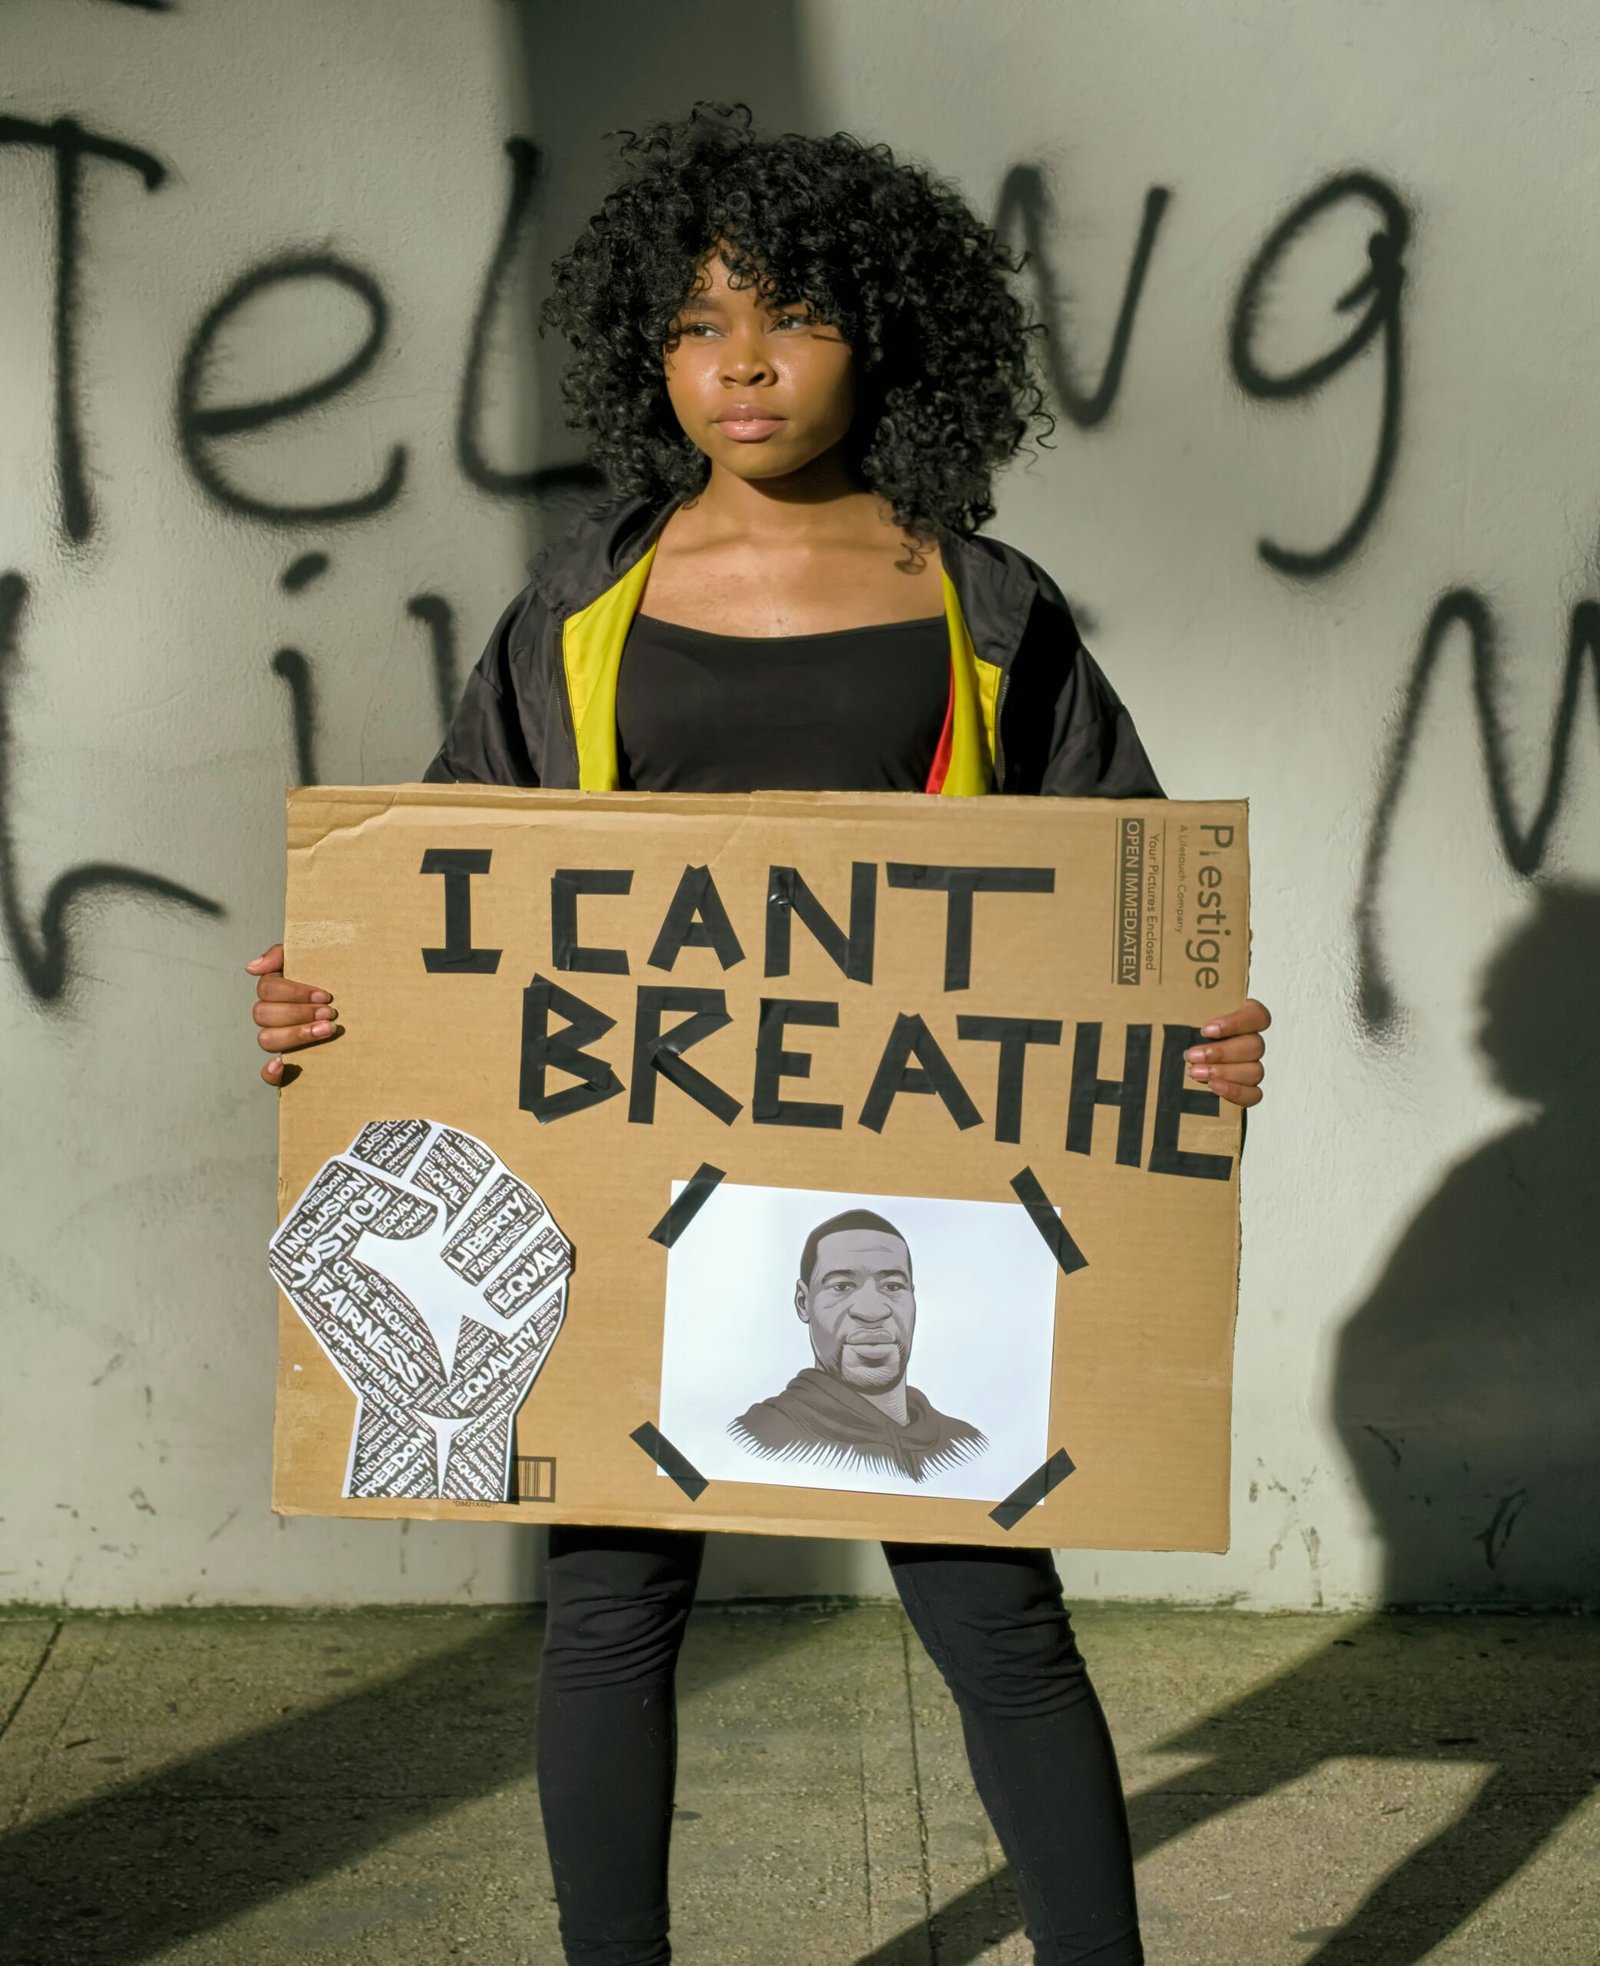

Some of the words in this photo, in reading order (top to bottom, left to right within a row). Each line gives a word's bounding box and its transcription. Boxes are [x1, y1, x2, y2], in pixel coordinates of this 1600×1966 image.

[1126, 821, 1139, 868] OPEN
[1148, 834, 1160, 862] Your
[1180, 824, 1189, 832] A
[1177, 835, 1189, 882] Lifetouch
[1147, 864, 1159, 912] Pictures
[1174, 884, 1187, 934] Company
[420, 848, 504, 974] I
[551, 861, 1055, 992] CANT
[1122, 872, 1138, 983] IMMEDIATELY
[1145, 916, 1158, 971] Enclosed
[519, 973, 1233, 1181] BREATHE
[361, 1120, 400, 1155] JUSTIC
[372, 1120, 423, 1166] EQUALITY
[455, 1137, 490, 1169] LIBERTY
[435, 1137, 483, 1183] FREEDOM
[448, 1166, 474, 1193] RIGHTS
[301, 1170, 347, 1214] FREEDOM
[421, 1161, 463, 1205] EQUAL
[470, 1179, 518, 1223] INCLUSION
[280, 1172, 368, 1255] INCLUSION
[375, 1199, 414, 1234] EQUAL
[395, 1205, 431, 1235] EQUAL
[446, 1191, 528, 1271] LIBERTY
[290, 1184, 392, 1288] JUSTICE
[448, 1224, 475, 1248] EQUALITY
[470, 1221, 528, 1276] FAIRNESS
[522, 1229, 550, 1256] EQUALITY
[368, 1274, 389, 1297] CIVIL
[388, 1294, 417, 1324] RIGHTS
[492, 1246, 565, 1311] EQUAL
[290, 1290, 321, 1320] FAIRNESS
[333, 1261, 370, 1302] CIVIL
[369, 1296, 425, 1352] RIGHTS
[530, 1294, 559, 1323] LIBERTY
[537, 1307, 560, 1331] JUSTICE
[310, 1274, 425, 1388] FAIRNESS
[456, 1328, 490, 1360] EQUALITY
[323, 1320, 415, 1407] OPPORTUNITY
[331, 1347, 365, 1376] JUSTICE
[420, 1350, 441, 1372] EQUAL
[450, 1321, 540, 1410] EQUALITY
[457, 1333, 499, 1375] LIBERTY
[503, 1350, 540, 1384] FAIRNESS
[356, 1380, 409, 1427] JUSTICE
[414, 1384, 440, 1408] LIBERTY
[427, 1375, 462, 1410] FREEDOM
[475, 1383, 504, 1411] INCLUSION
[359, 1416, 388, 1445] LIBERTY
[456, 1384, 519, 1446] OPPORTUNITY
[467, 1410, 508, 1449] INCLUSION
[356, 1432, 409, 1481] INCLUSION
[356, 1428, 433, 1498] FREEDOM
[359, 1423, 398, 1464] JUSTICE
[483, 1438, 503, 1463] EQUAL
[462, 1447, 500, 1488] FAIRNESS
